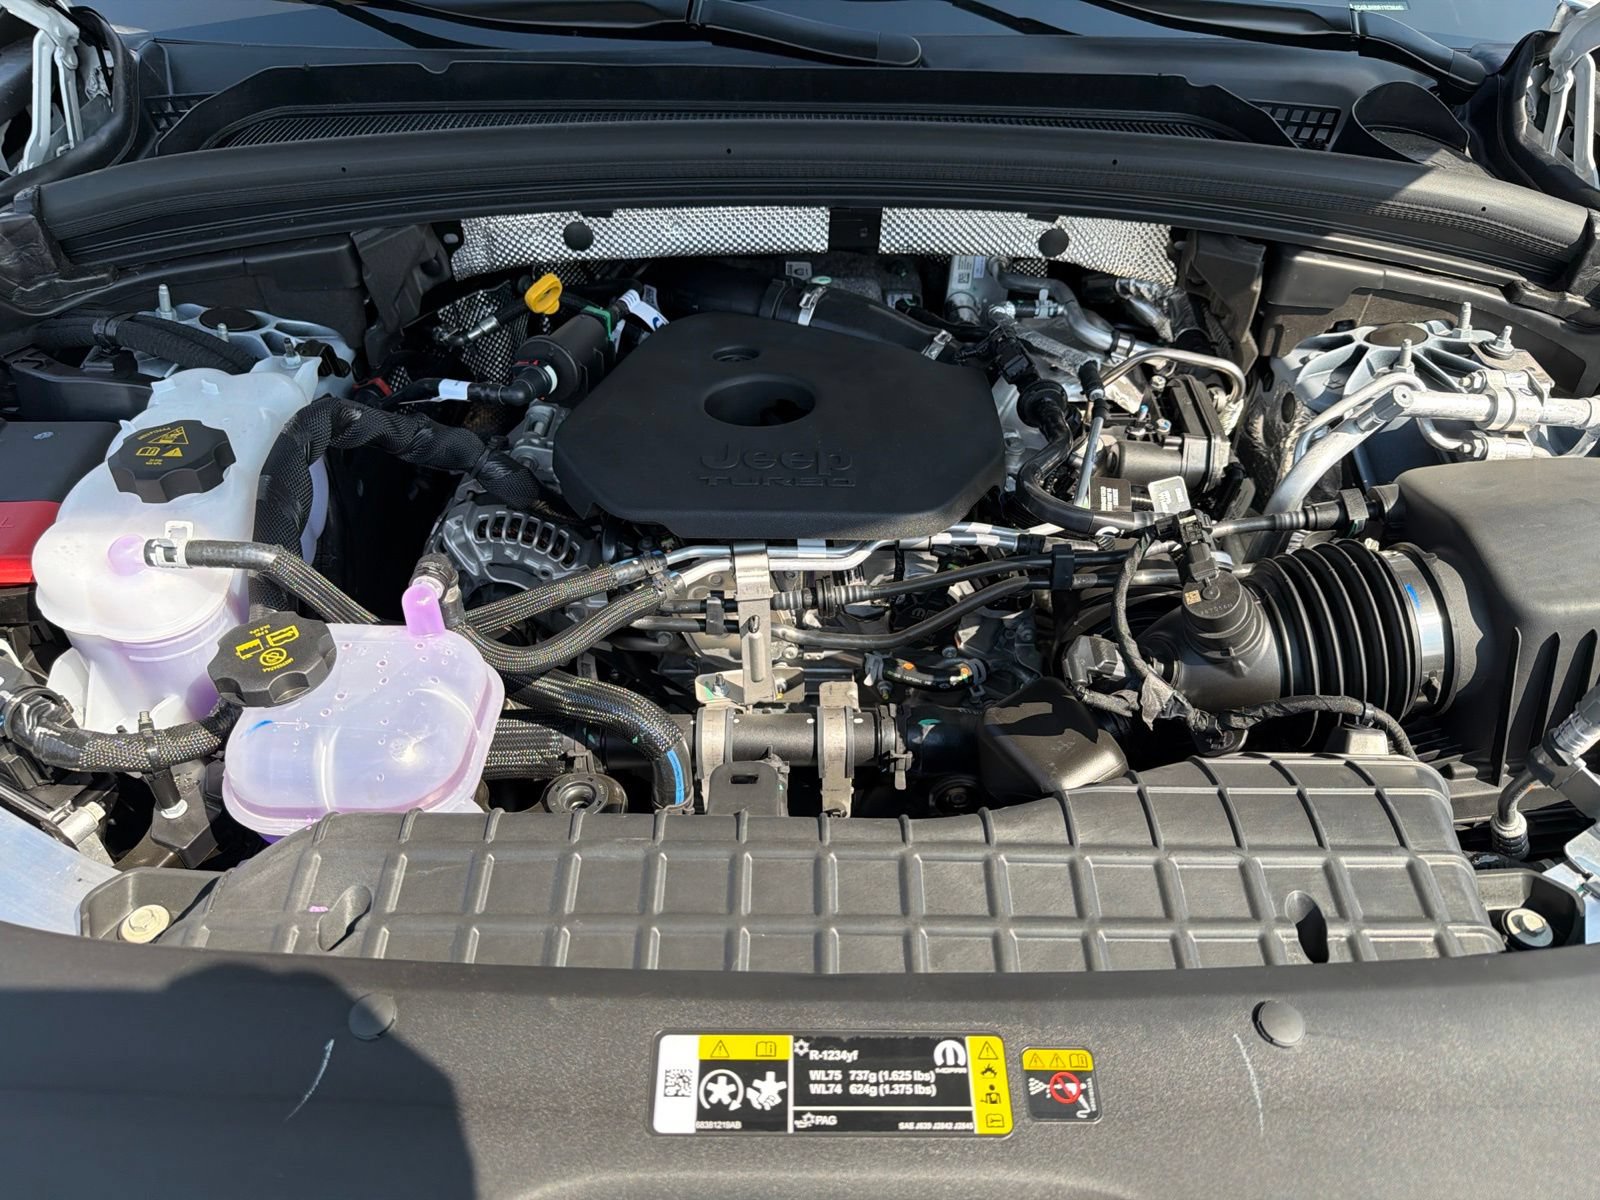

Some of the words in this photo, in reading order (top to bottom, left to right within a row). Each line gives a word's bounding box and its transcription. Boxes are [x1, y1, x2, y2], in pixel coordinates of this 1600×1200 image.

[700, 443, 853, 475] Jeep
[699, 476, 855, 488] TURBO
[809, 1050, 858, 1062] R-1234yf
[809, 1070, 843, 1081] WL75
[849, 1070, 877, 1083] 737g
[878, 1070, 913, 1083] (1.625
[913, 1070, 936, 1083] lbs)
[809, 1083, 843, 1095] WL74
[849, 1084, 878, 1097] 624g
[878, 1083, 913, 1096] (1.375
[914, 1083, 937, 1097] lbs)
[815, 1115, 837, 1126] PAG
